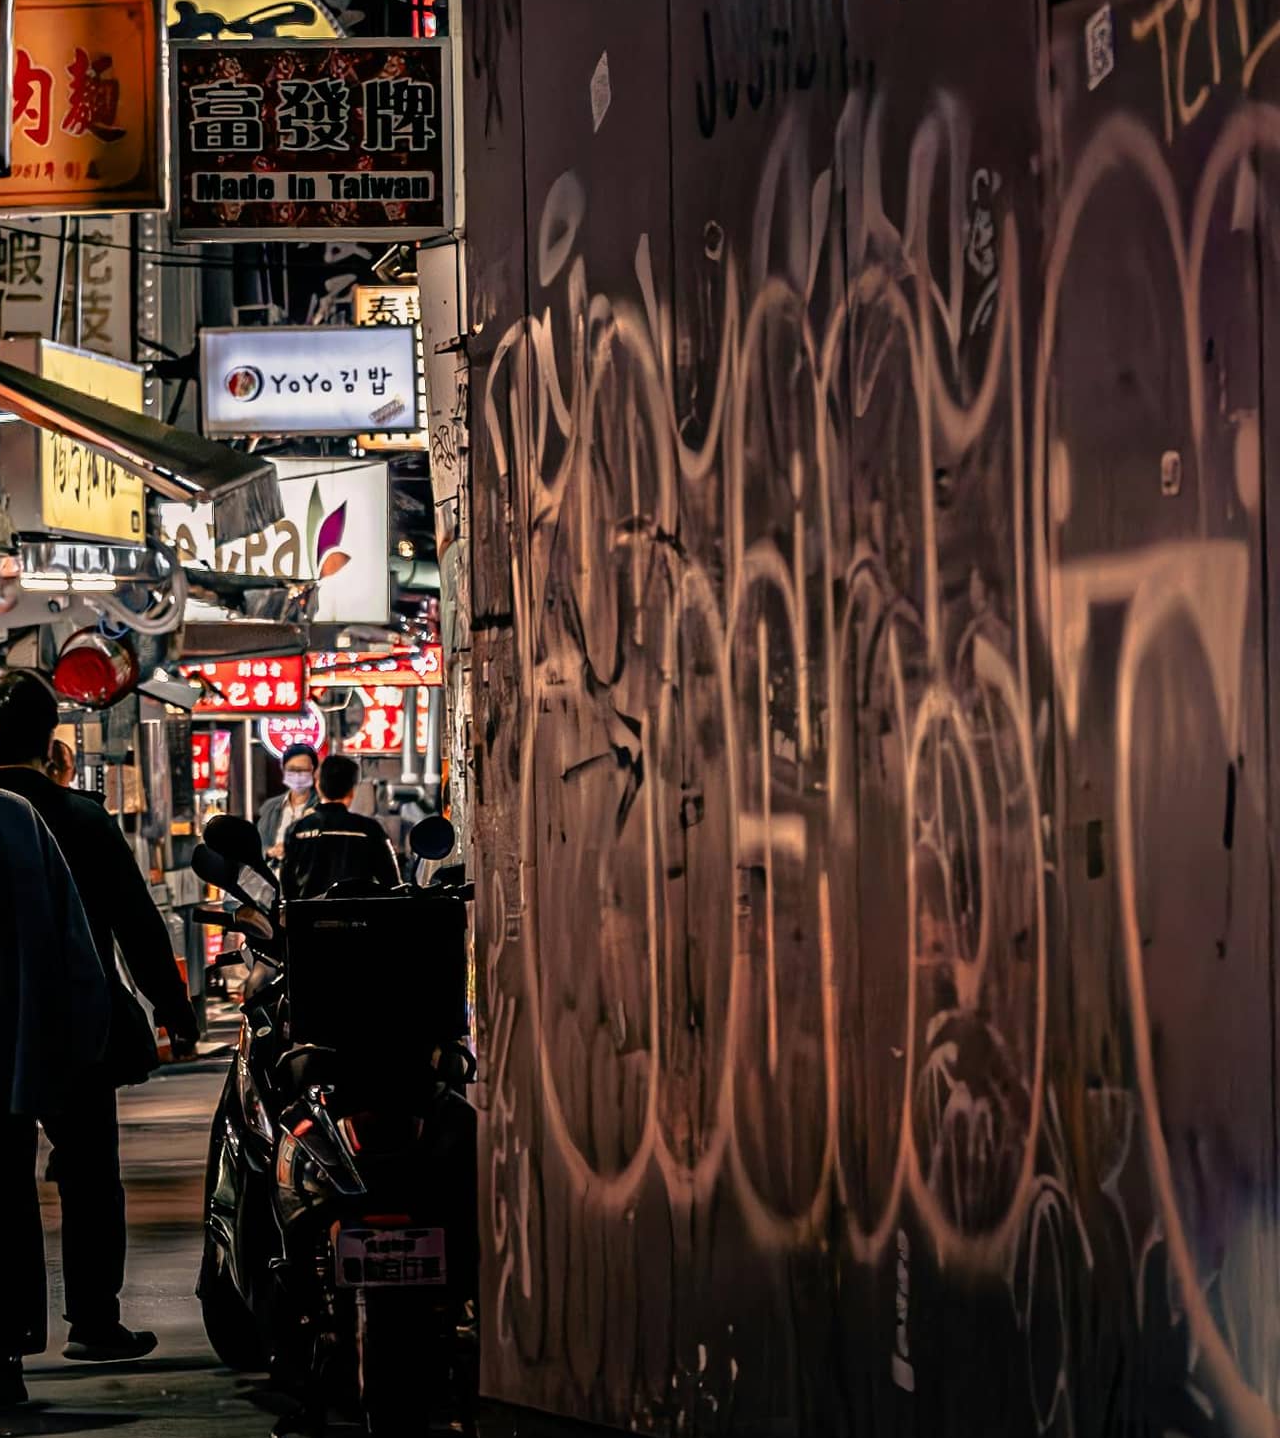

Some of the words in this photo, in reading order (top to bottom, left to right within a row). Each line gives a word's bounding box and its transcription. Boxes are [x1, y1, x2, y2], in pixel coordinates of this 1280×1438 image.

[188, 78, 437, 153] 富發牌
[196, 174, 275, 200] Made
[328, 173, 431, 200] Taiwan
[270, 373, 333, 394] YoYo
[339, 366, 393, 396] 김밥
